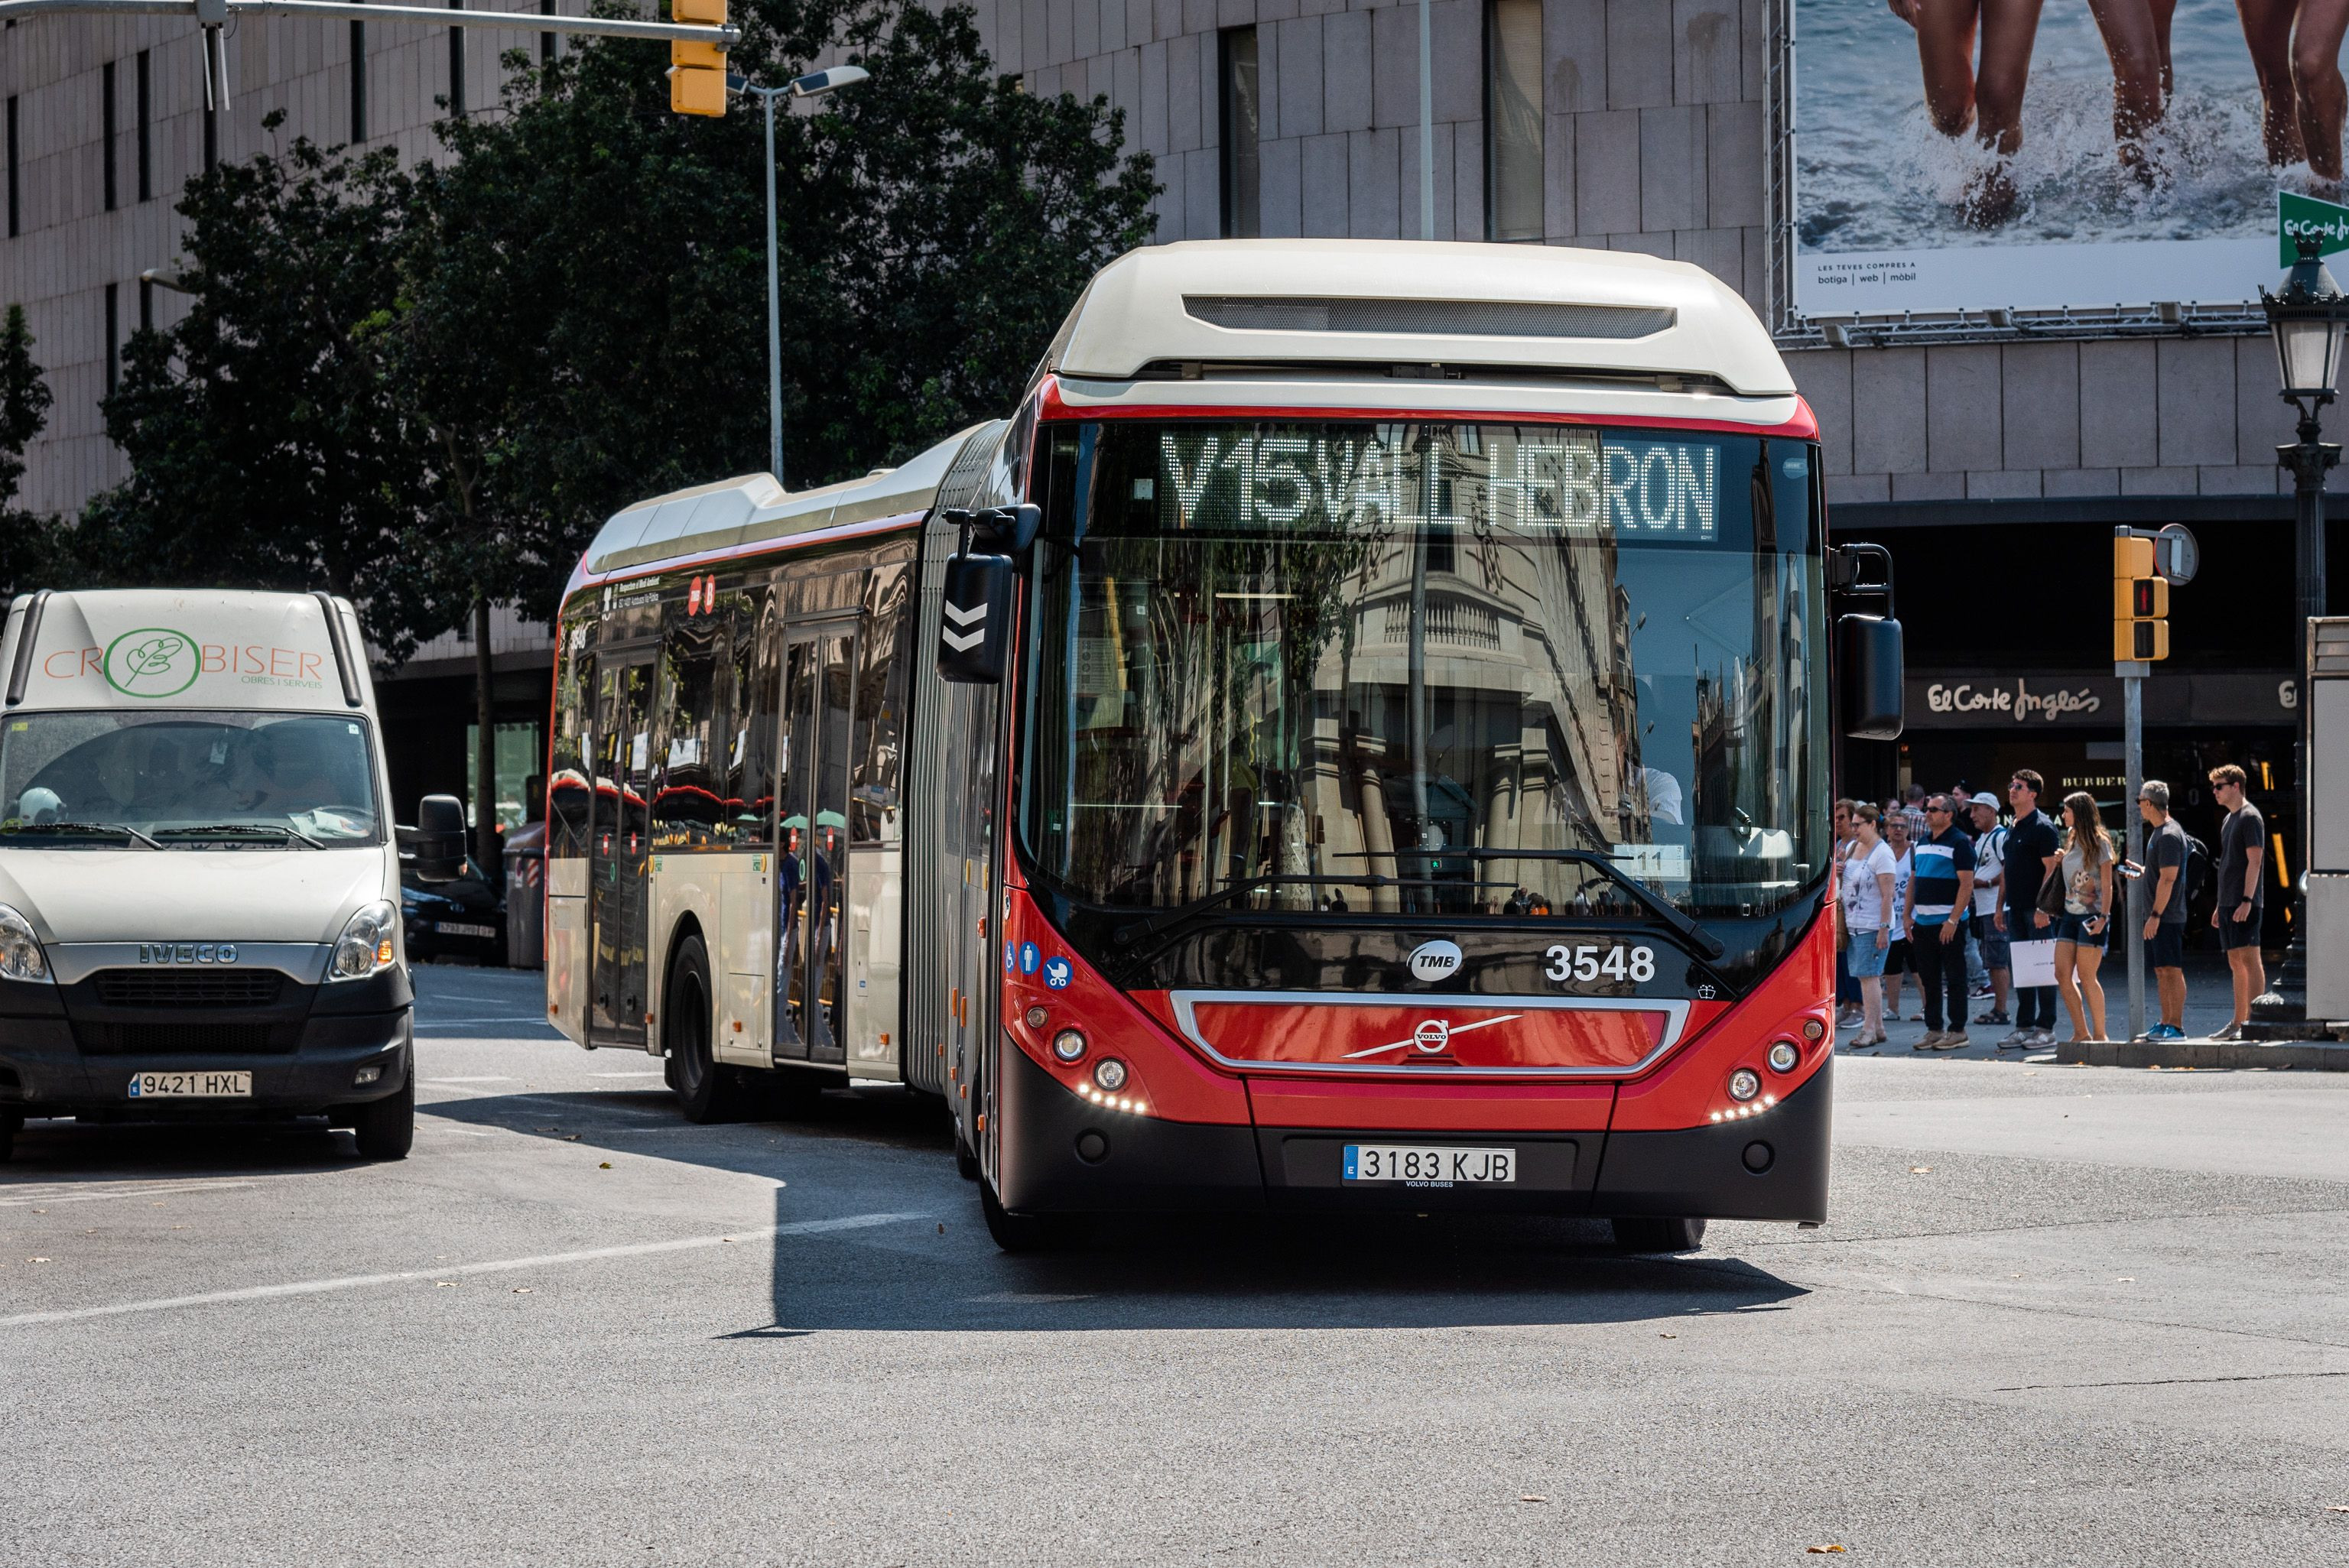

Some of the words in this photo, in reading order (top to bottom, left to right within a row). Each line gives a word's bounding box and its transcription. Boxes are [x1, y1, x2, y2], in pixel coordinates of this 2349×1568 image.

[1818, 276, 1847, 284] botiga
[1860, 274, 1879, 282] web
[1890, 272, 1916, 281] mòbil
[1162, 437, 1311, 521] V15
[1318, 439, 1466, 525] VALL
[1490, 443, 1714, 530] HEBRON
[242, 676, 275, 685] OBRES
[284, 678, 322, 688] SERVEIS
[1928, 684, 1952, 712] El
[1954, 685, 2011, 711] Corte
[2014, 677, 2100, 721] Inglés
[2279, 680, 2297, 709] E
[2062, 775, 2126, 787] BURBER
[1637, 851, 1661, 871] 11
[140, 944, 239, 964] IVECO
[1420, 956, 1455, 968] TMB
[1545, 945, 1655, 982] 3548
[144, 1076, 196, 1093] 9421
[206, 1075, 245, 1093] HXL
[1347, 1166, 1354, 1174] E
[1364, 1151, 1440, 1179] 3183
[1453, 1153, 1509, 1181] KJB
